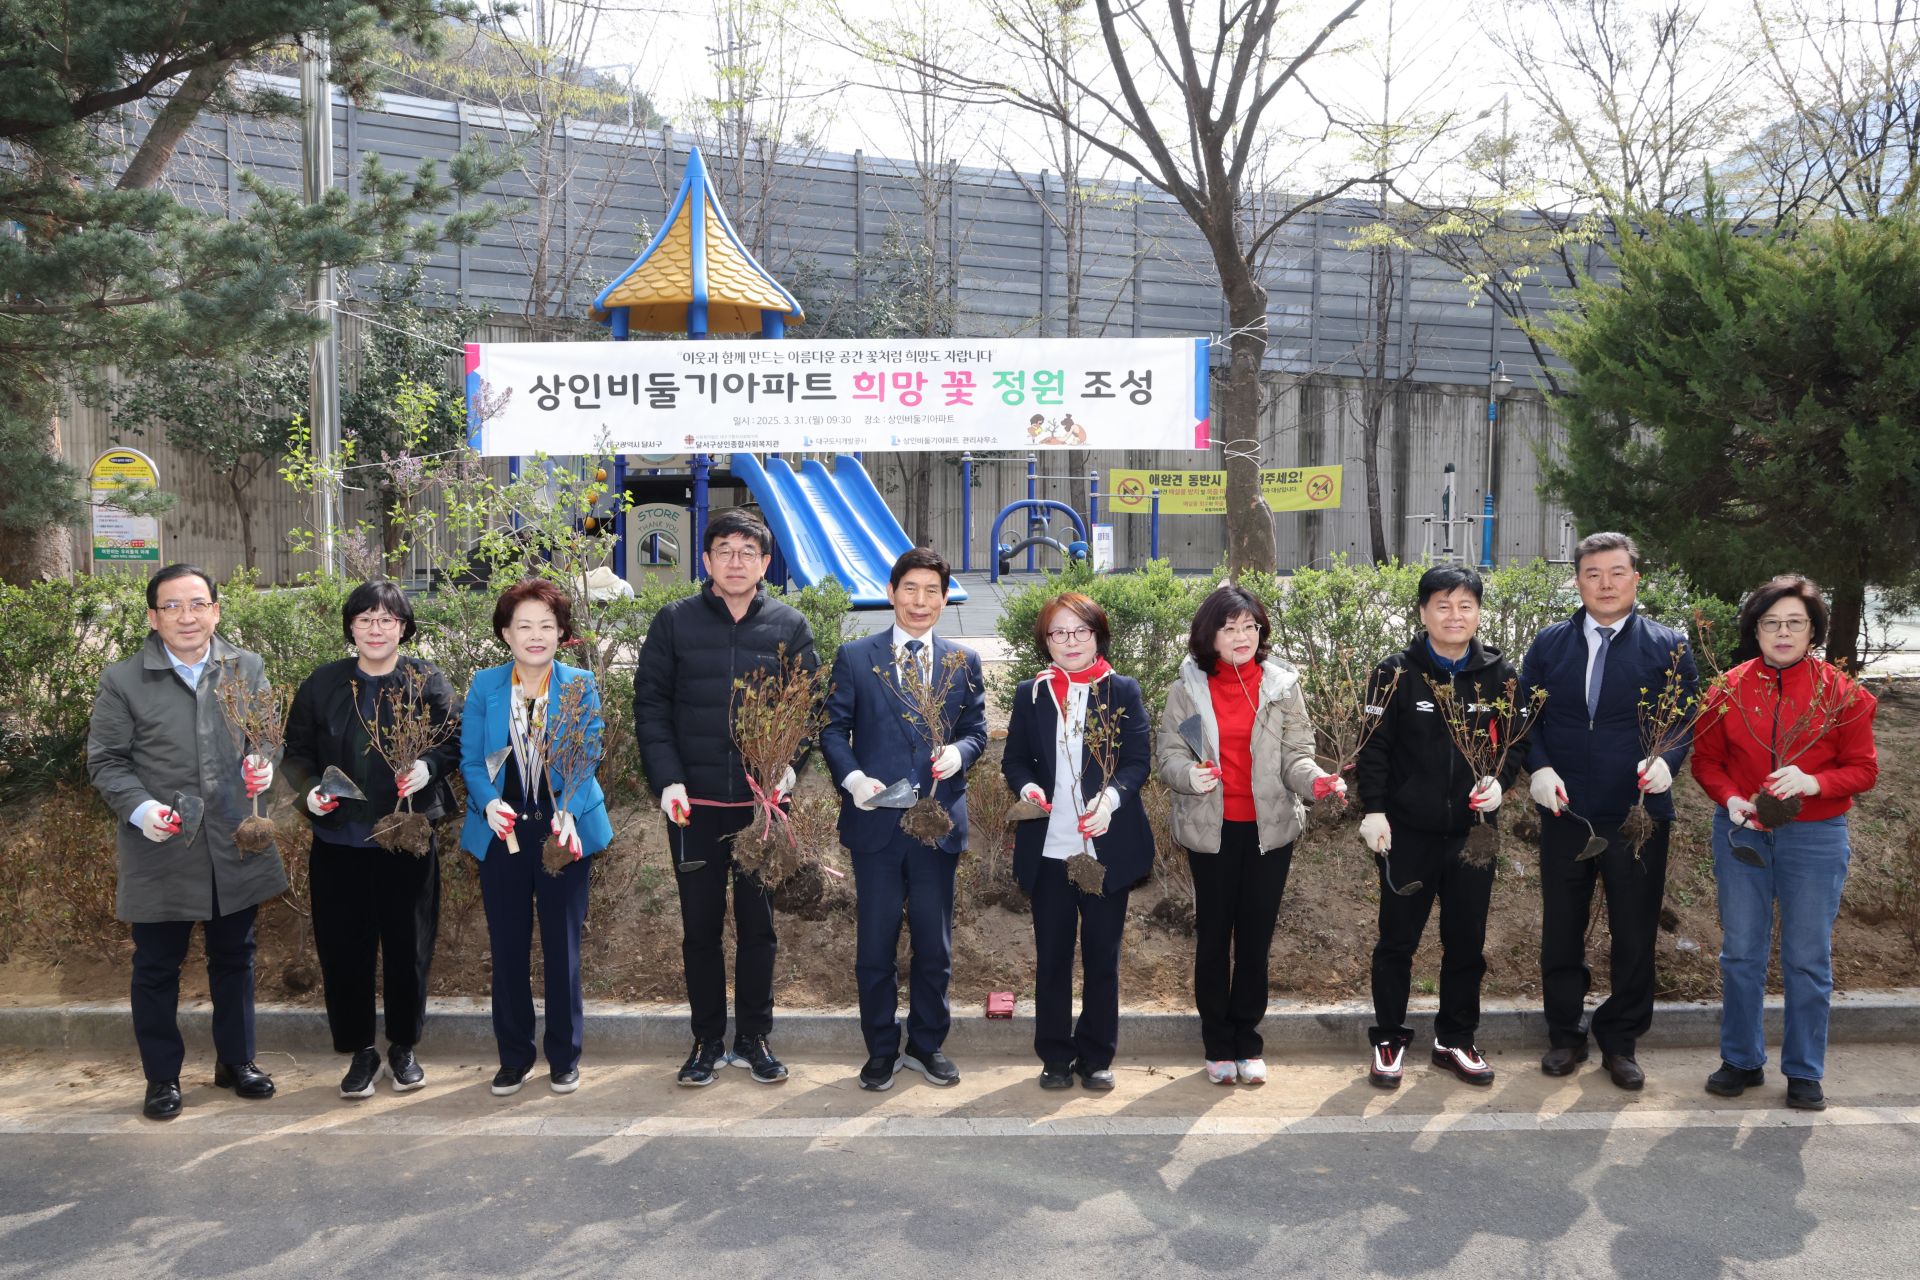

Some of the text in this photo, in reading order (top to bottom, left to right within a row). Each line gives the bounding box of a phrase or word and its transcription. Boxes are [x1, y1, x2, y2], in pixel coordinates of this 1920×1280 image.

[722, 351, 746, 365] 함께
[749, 351, 785, 364] 만드는
[788, 350, 836, 364] 아름다운
[839, 350, 863, 364] 공간
[866, 350, 902, 364] 꽃처럼
[905, 350, 942, 364] 희망도
[528, 369, 1153, 411] 상인비둘기아파트 희망 꽃 정원 조성
[732, 416, 750, 425] 일시
[756, 416, 782, 425] 2025.
[783, 416, 792, 425] 3.
[826, 416, 851, 425] 09:30
[864, 415, 880, 424] 장소
[887, 414, 956, 424] 상인비둘기아파트
[641, 440, 663, 449] 달서구
[1148, 473, 1222, 487] 애완견 동반시
[637, 508, 681, 522] STORE
[638, 520, 680, 533] THANK YOU
